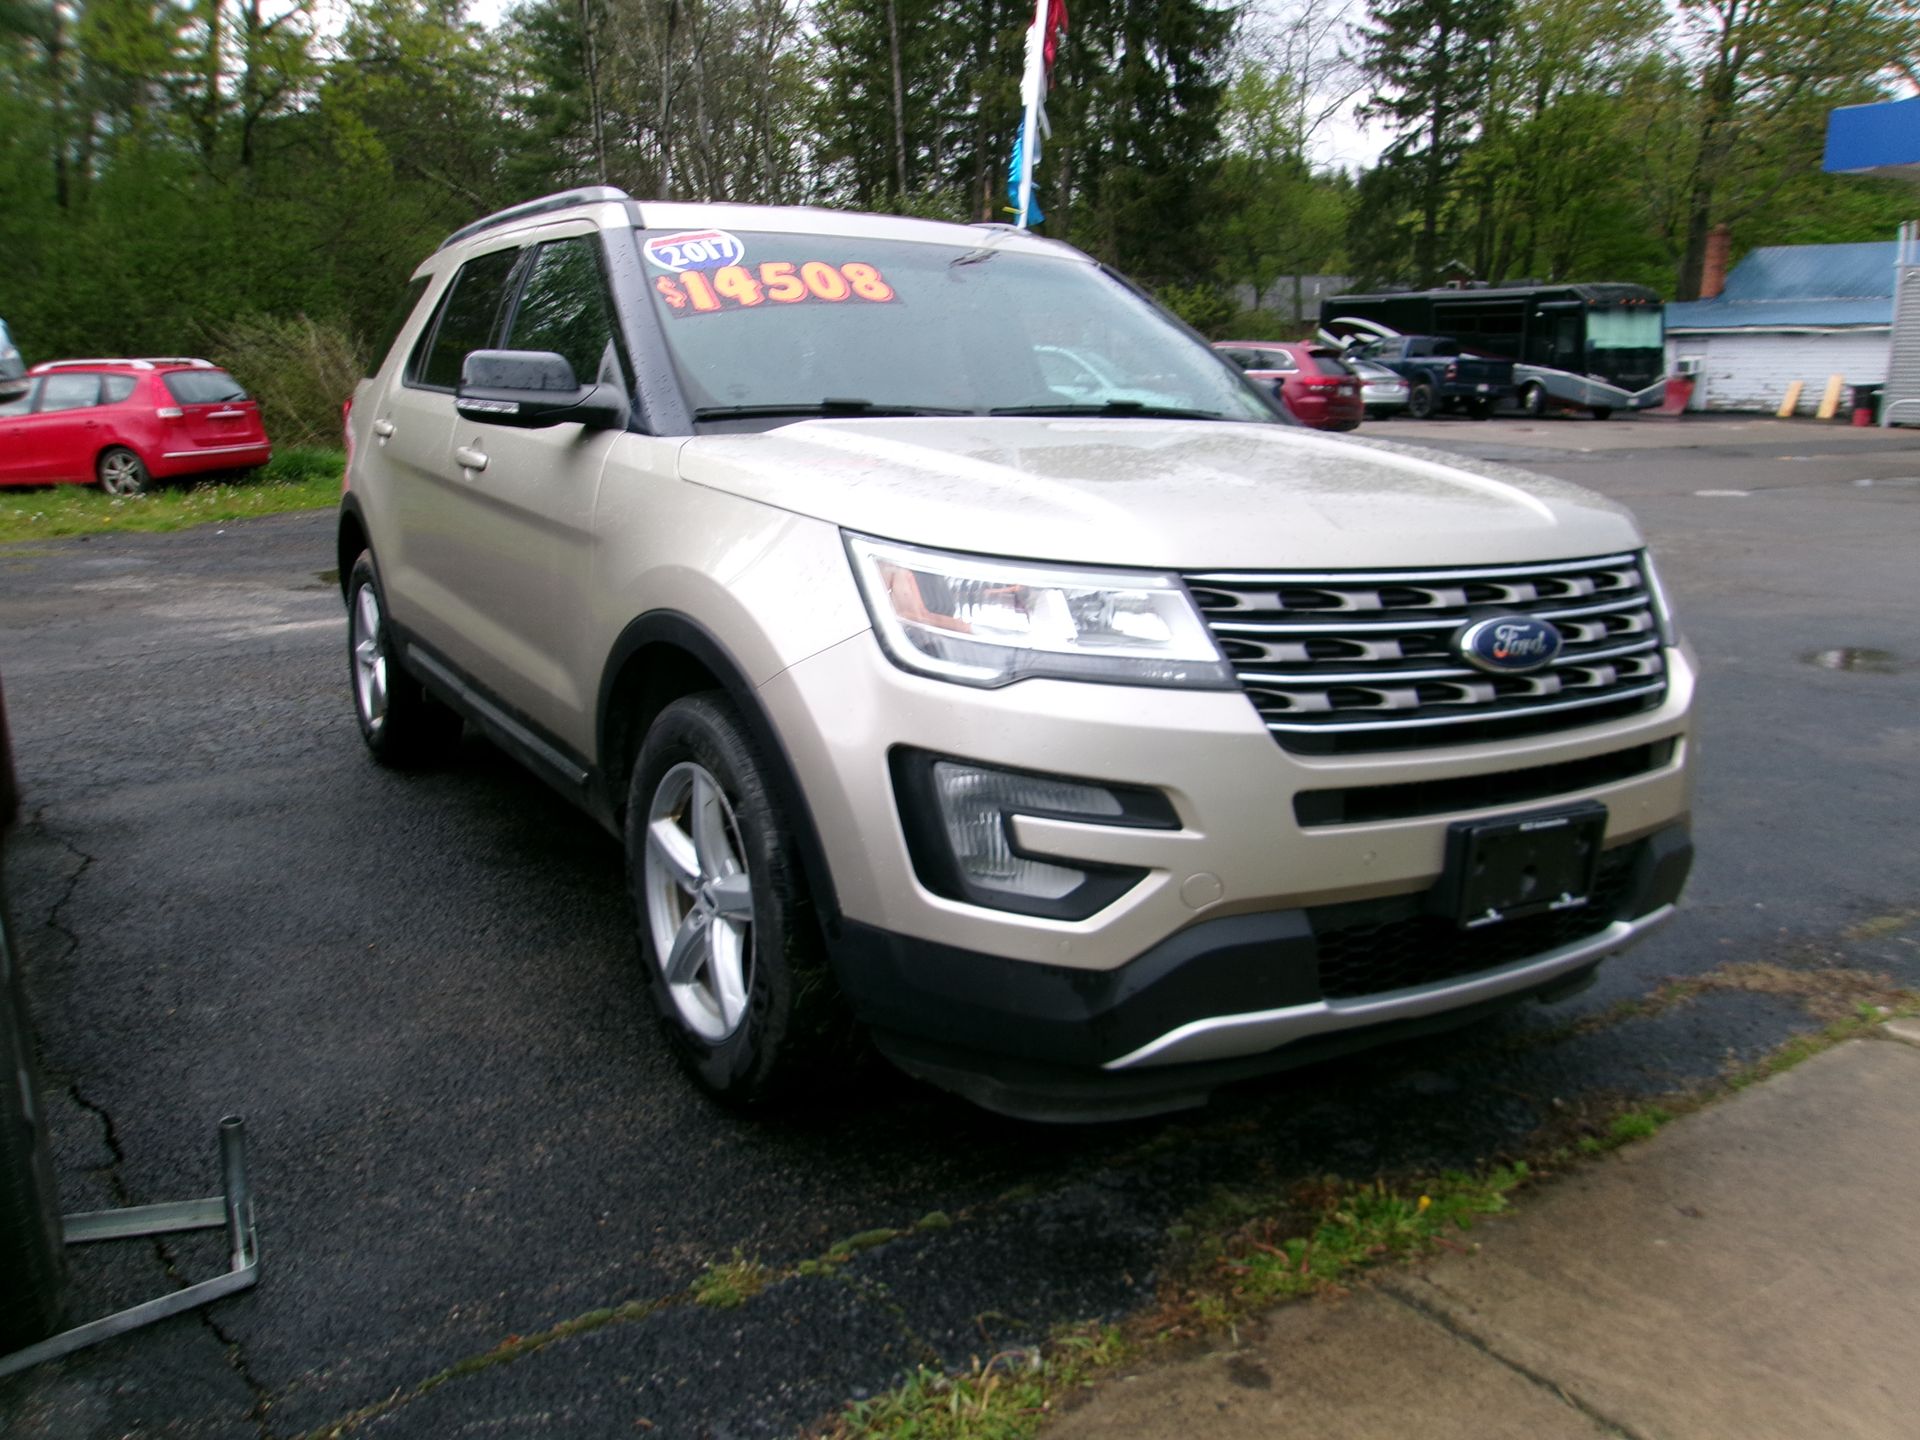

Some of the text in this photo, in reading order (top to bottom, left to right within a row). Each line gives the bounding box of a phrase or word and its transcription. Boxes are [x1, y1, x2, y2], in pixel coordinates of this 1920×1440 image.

[660, 239, 734, 267] 2017
[656, 261, 894, 312] $14508
[1493, 624, 1547, 658] Ford
